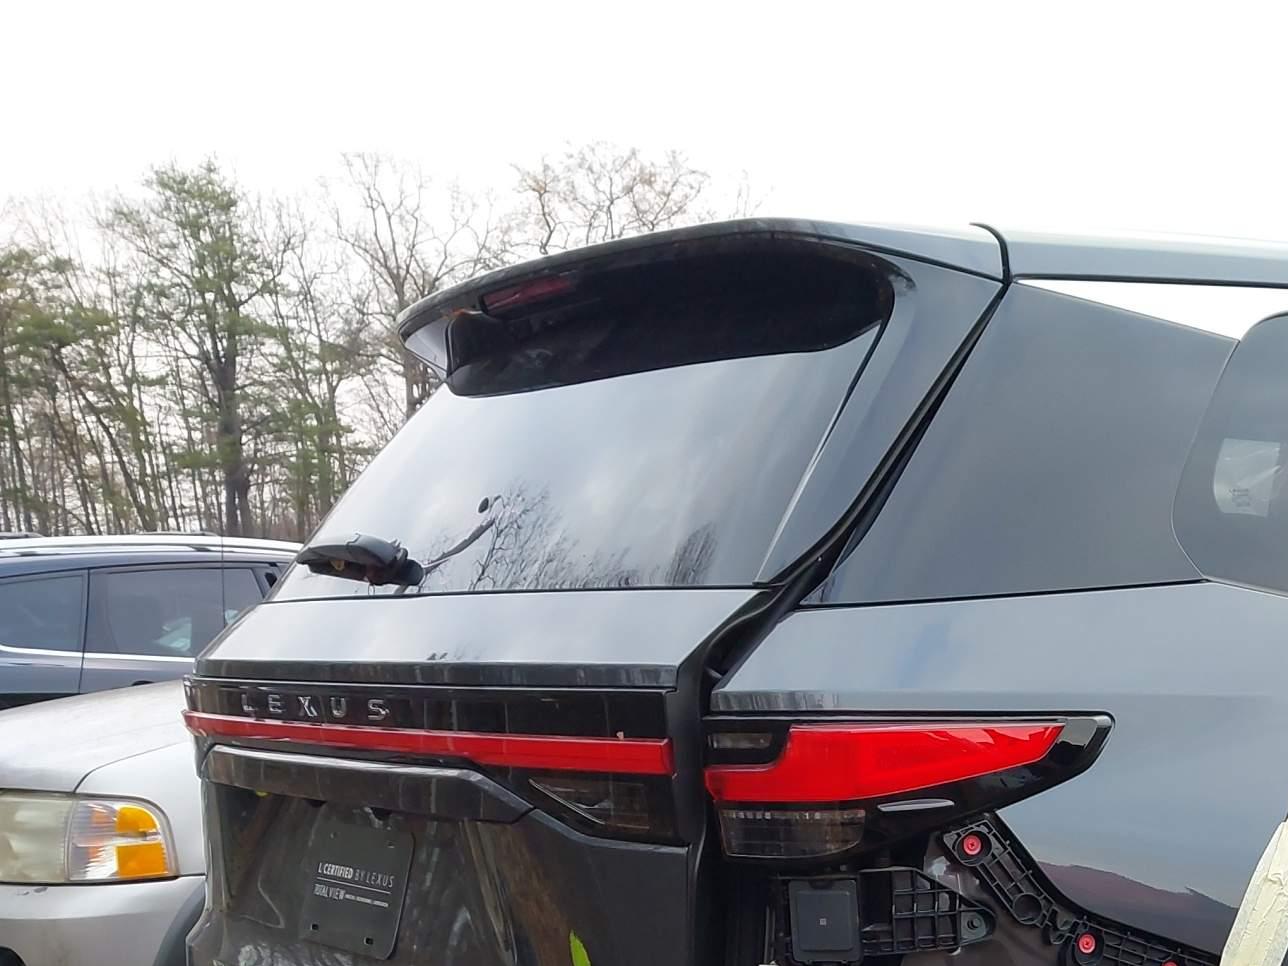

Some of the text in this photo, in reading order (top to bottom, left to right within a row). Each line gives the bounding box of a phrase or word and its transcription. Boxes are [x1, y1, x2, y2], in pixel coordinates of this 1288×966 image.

[241, 693, 390, 721] LEXUS
[323, 863, 354, 879] CERTIFIED
[354, 869, 366, 881] BY
[366, 872, 395, 888] LEXUS
[328, 887, 346, 901] VIEW
